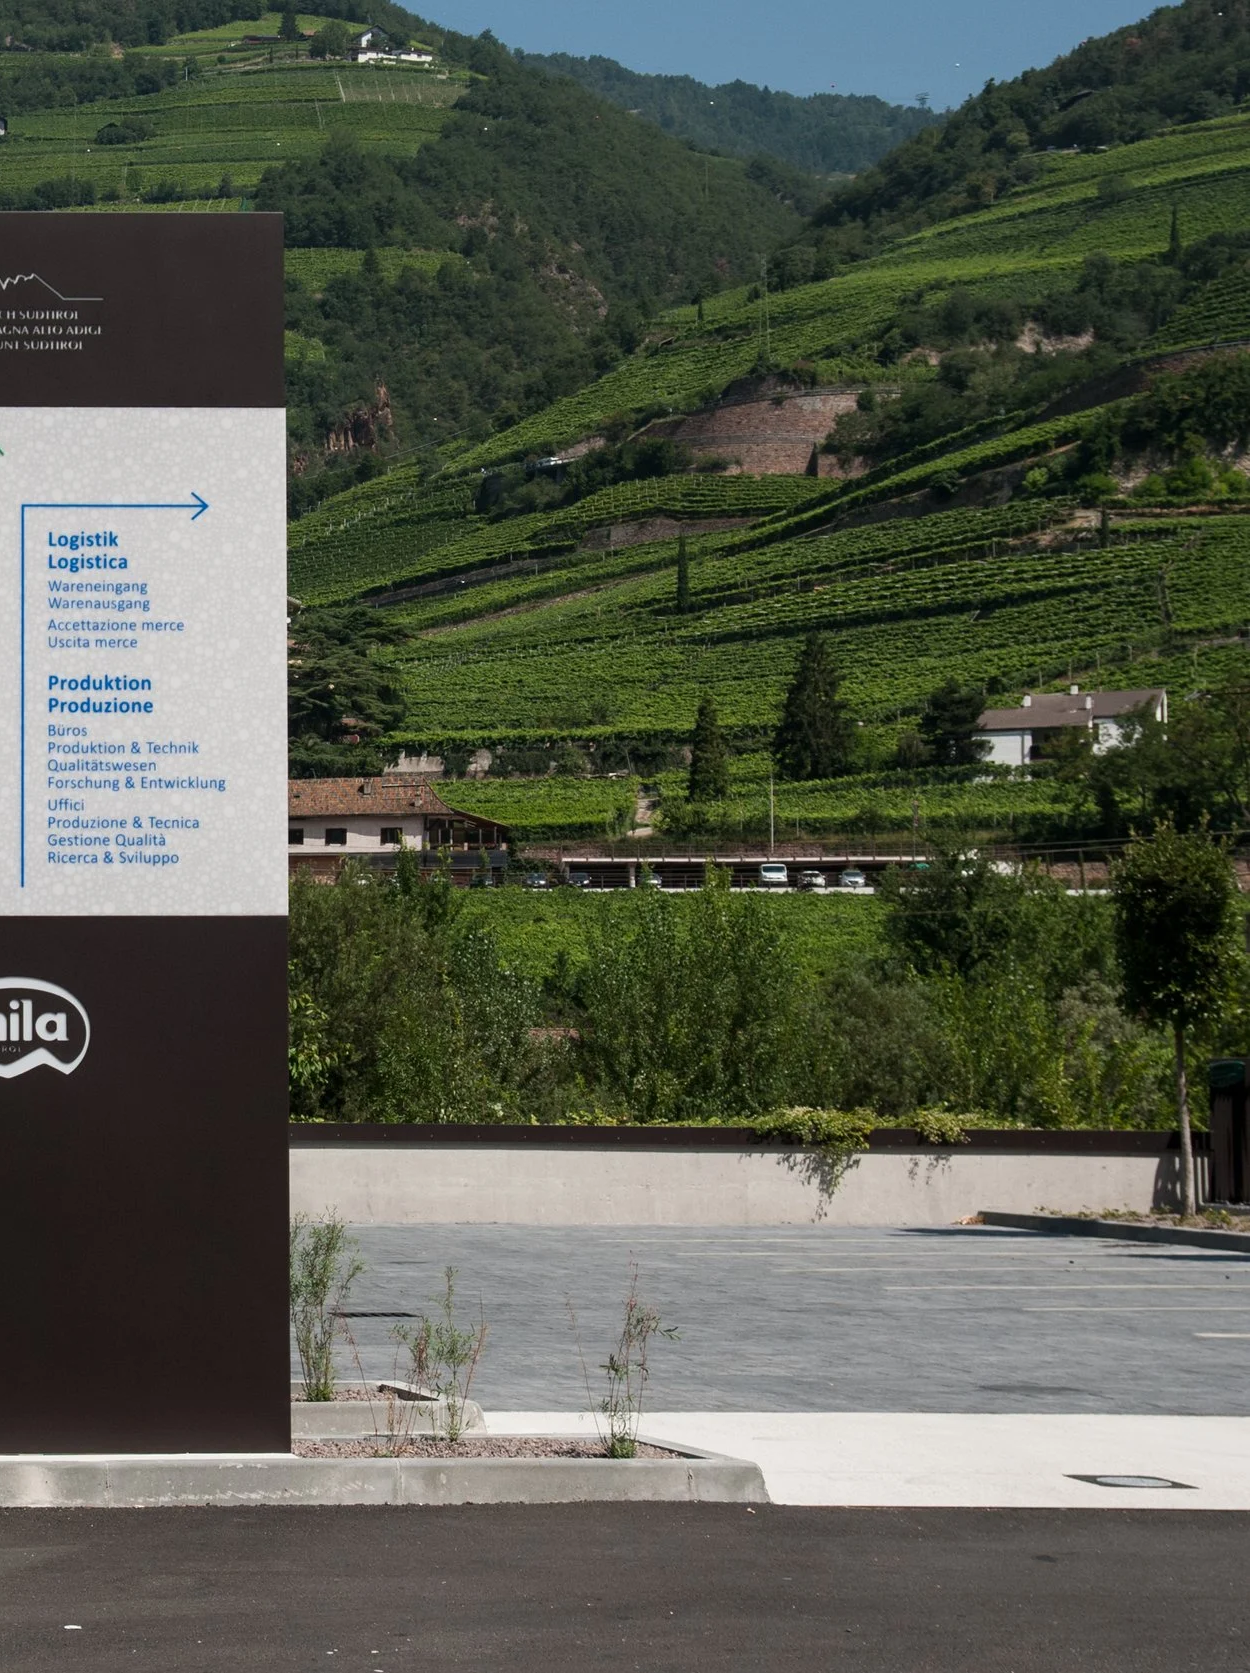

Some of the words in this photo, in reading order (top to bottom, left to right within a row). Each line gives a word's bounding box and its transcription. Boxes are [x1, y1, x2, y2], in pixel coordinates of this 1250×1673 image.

[47, 531, 119, 551] Logistik
[47, 553, 129, 573] Logistica
[48, 580, 148, 595] Wareneingang
[48, 597, 150, 612] Warenausgang
[47, 618, 138, 633] Accettazione
[141, 621, 185, 633] merce
[47, 635, 91, 649] Uscita
[95, 638, 139, 649] merce
[47, 674, 153, 692] Produktion
[47, 696, 155, 714] Produzione
[47, 723, 88, 737] Büros
[47, 741, 126, 755] Produktion
[130, 741, 142, 755] &
[146, 741, 199, 755] Technik
[47, 758, 157, 773] Qualitätswesen
[47, 776, 120, 792] Forschung
[124, 776, 136, 790] &
[140, 776, 227, 792] Entwicklung
[47, 798, 86, 812] Uffici
[47, 816, 128, 829] Produzione
[132, 815, 144, 829] &
[148, 816, 200, 829] Tecnica
[47, 833, 111, 847] Gestione
[115, 833, 167, 849] Qualità
[47, 851, 98, 865] Ricerca
[102, 851, 115, 865] &
[118, 851, 180, 867] Sviluppo
